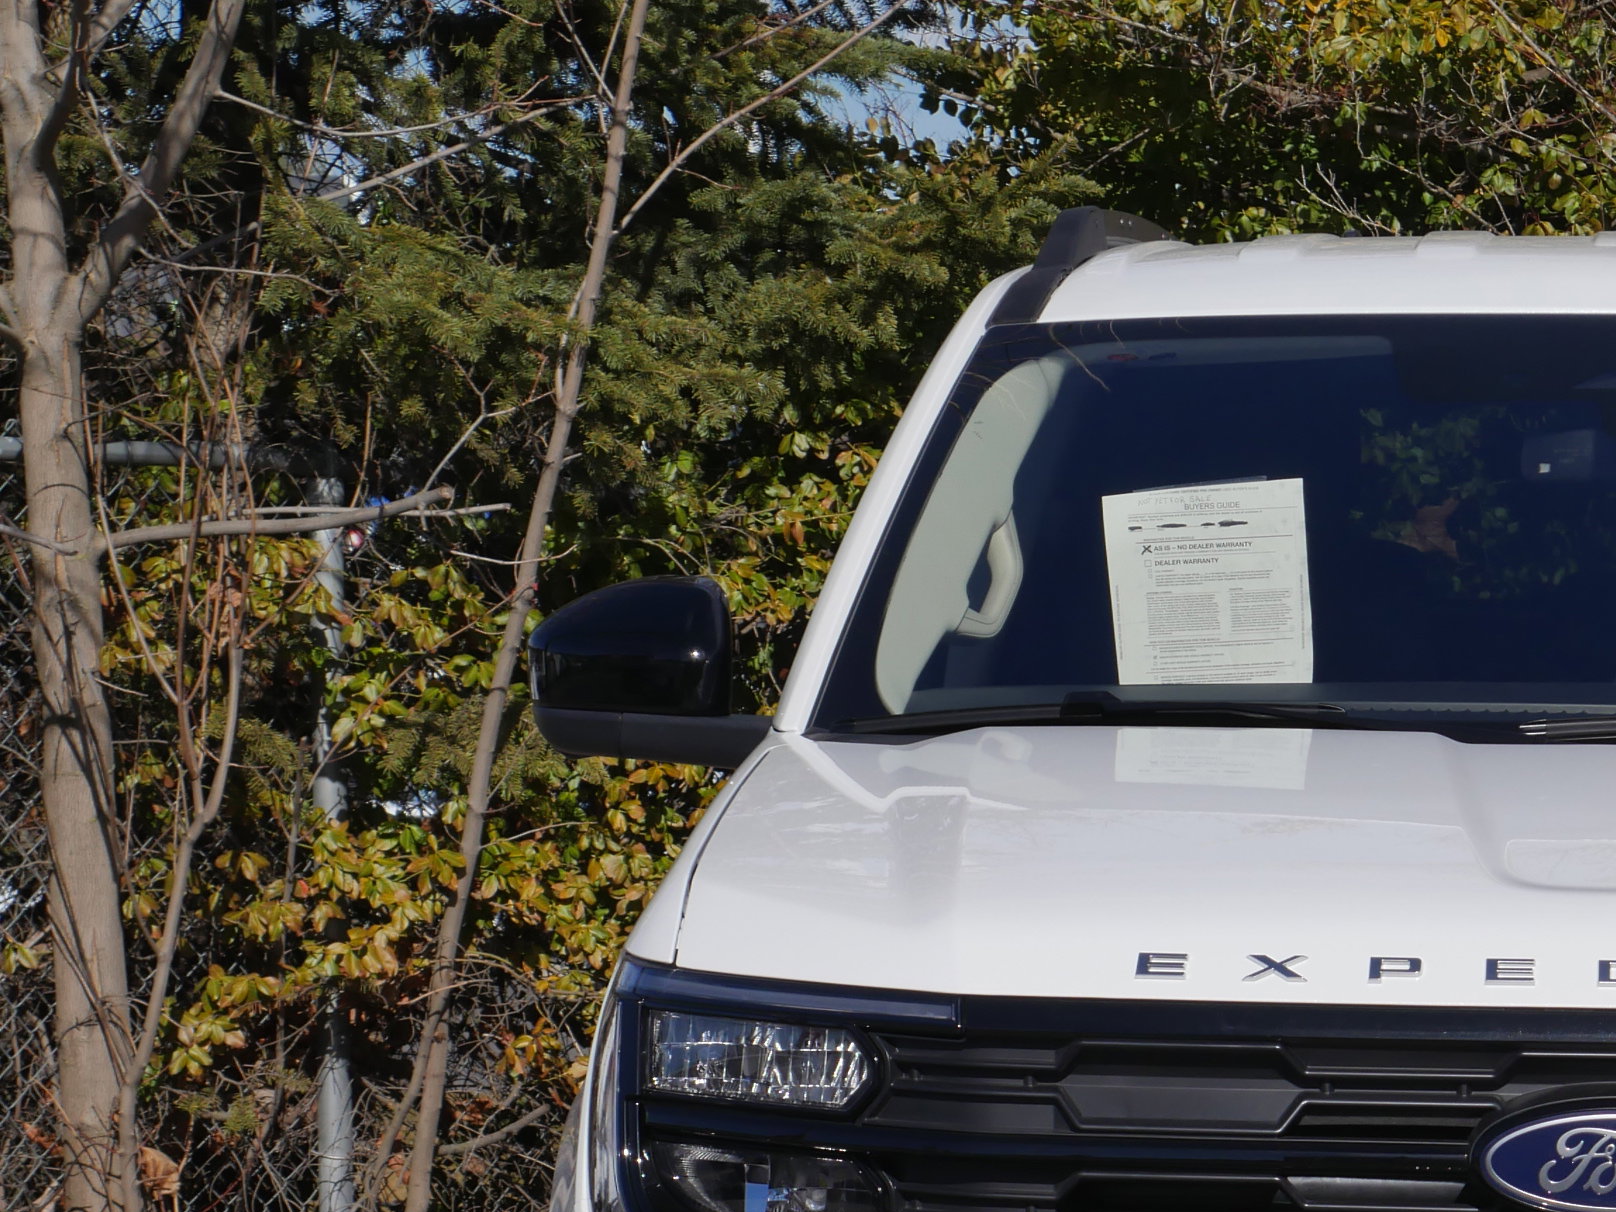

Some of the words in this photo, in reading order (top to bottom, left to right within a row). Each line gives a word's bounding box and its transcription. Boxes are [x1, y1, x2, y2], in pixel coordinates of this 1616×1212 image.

[1169, 495, 1185, 505] FOR
[1189, 495, 1212, 503] SALE
[1184, 502, 1215, 511] BUYERS
[1217, 501, 1240, 509] GUIDE
[1215, 541, 1253, 549] WARRANTY
[1154, 559, 1181, 567] DEALER
[1182, 557, 1219, 565] WARRANTY
